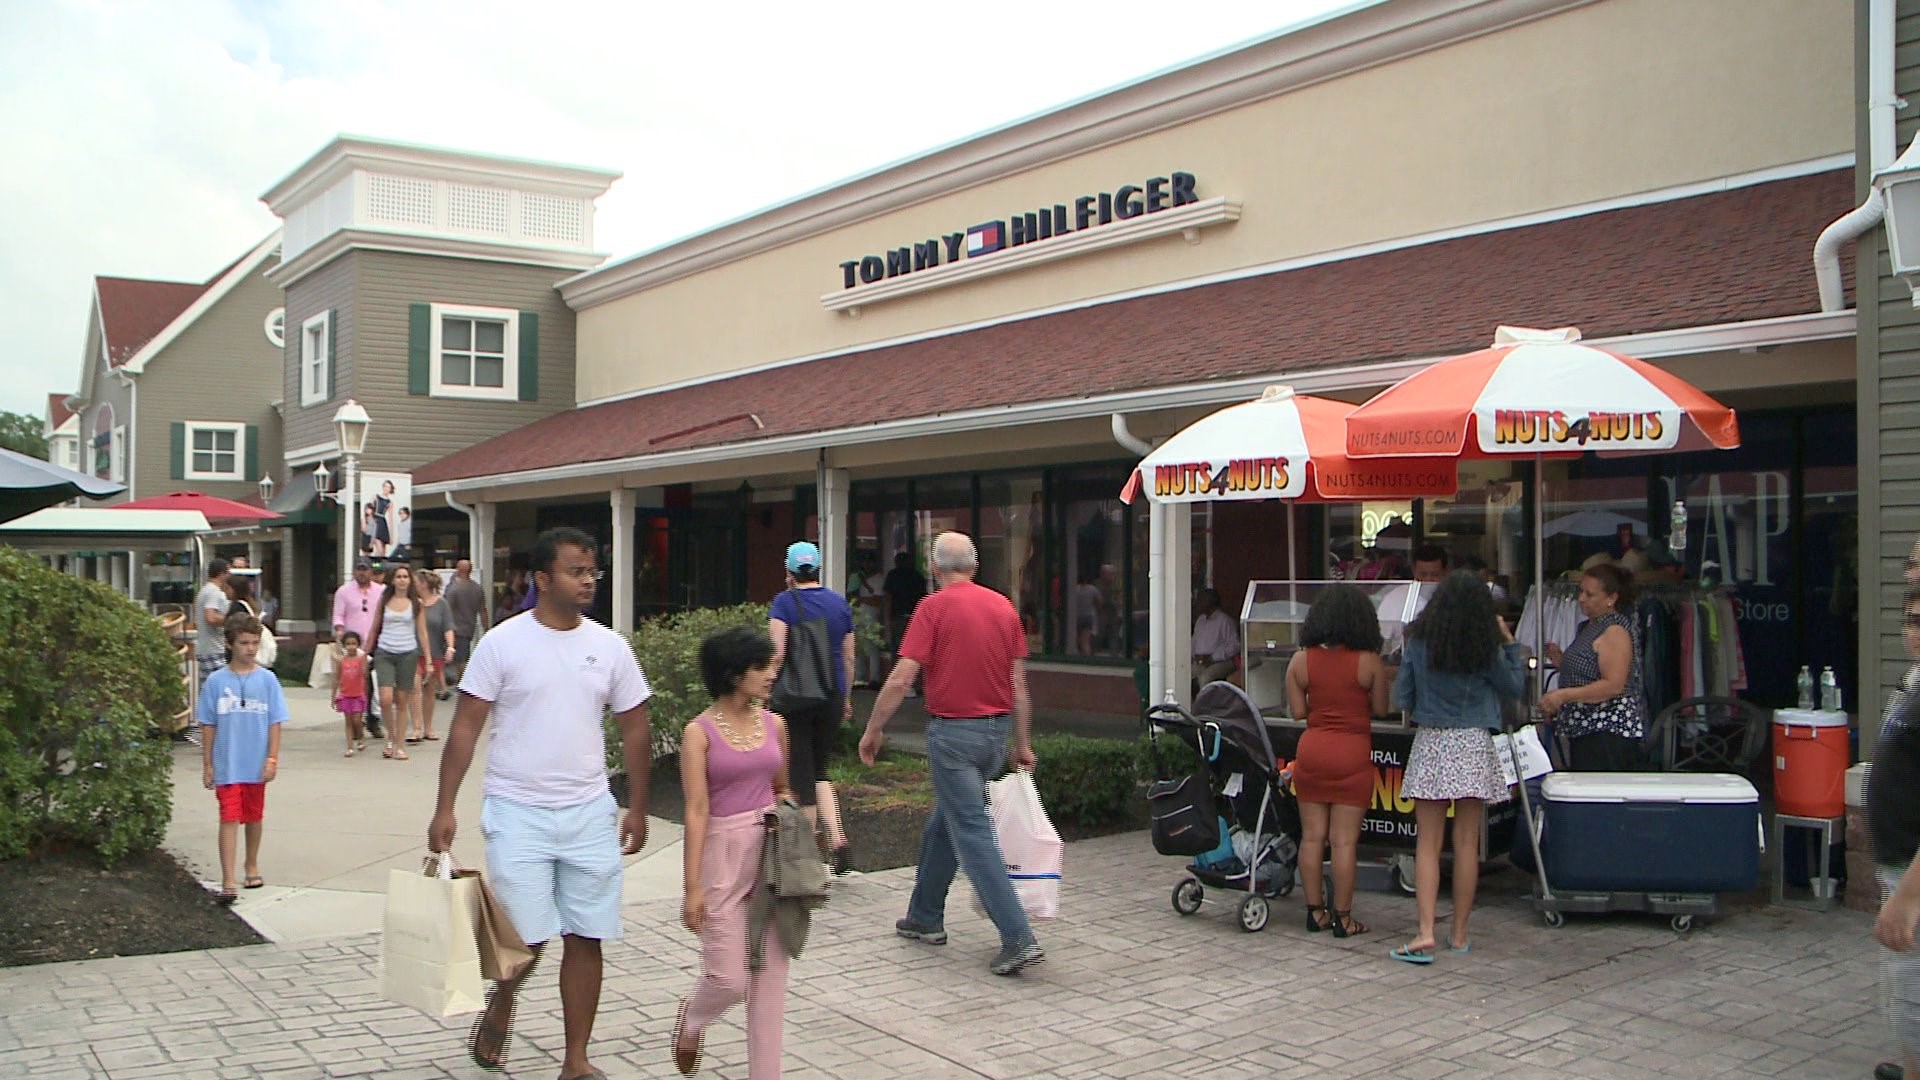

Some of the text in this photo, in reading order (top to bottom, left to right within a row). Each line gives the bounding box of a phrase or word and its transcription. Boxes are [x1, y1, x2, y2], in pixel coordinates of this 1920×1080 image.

[839, 171, 1200, 289] TOMMY HILFIGER
[1352, 430, 1457, 448] NUTS4NUTS.COM
[1495, 408, 1663, 446] NUTS4NUTS
[1155, 456, 1289, 496] NUTS4NUTS
[1360, 818, 1418, 837] STED NU
